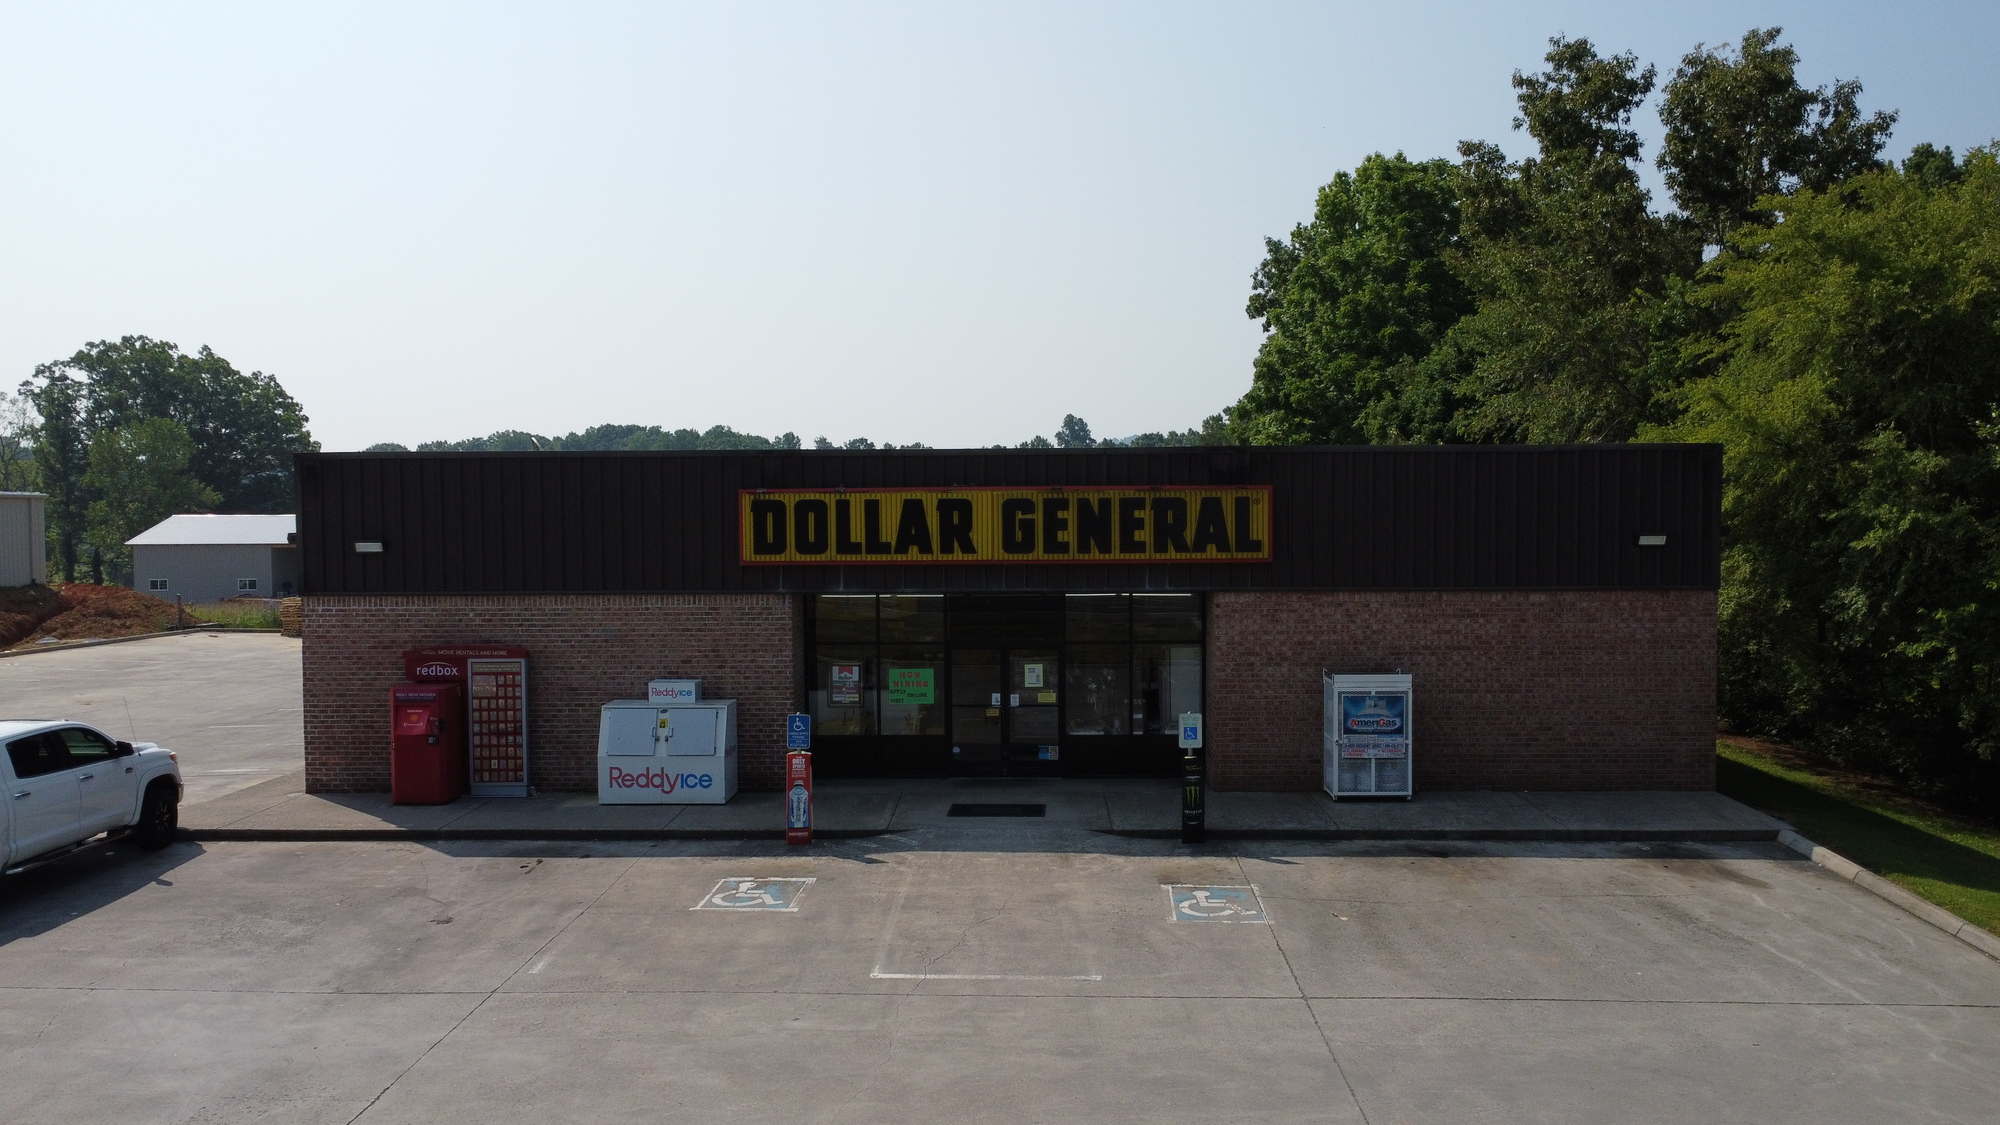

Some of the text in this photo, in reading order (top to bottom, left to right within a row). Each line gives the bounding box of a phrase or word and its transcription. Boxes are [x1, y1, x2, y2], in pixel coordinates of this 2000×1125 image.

[750, 496, 1262, 556] DOLLAR GENERAL
[416, 664, 459, 676] redbox
[893, 680, 929, 688] HIRING
[1350, 718, 1397, 727] AmeriGas
